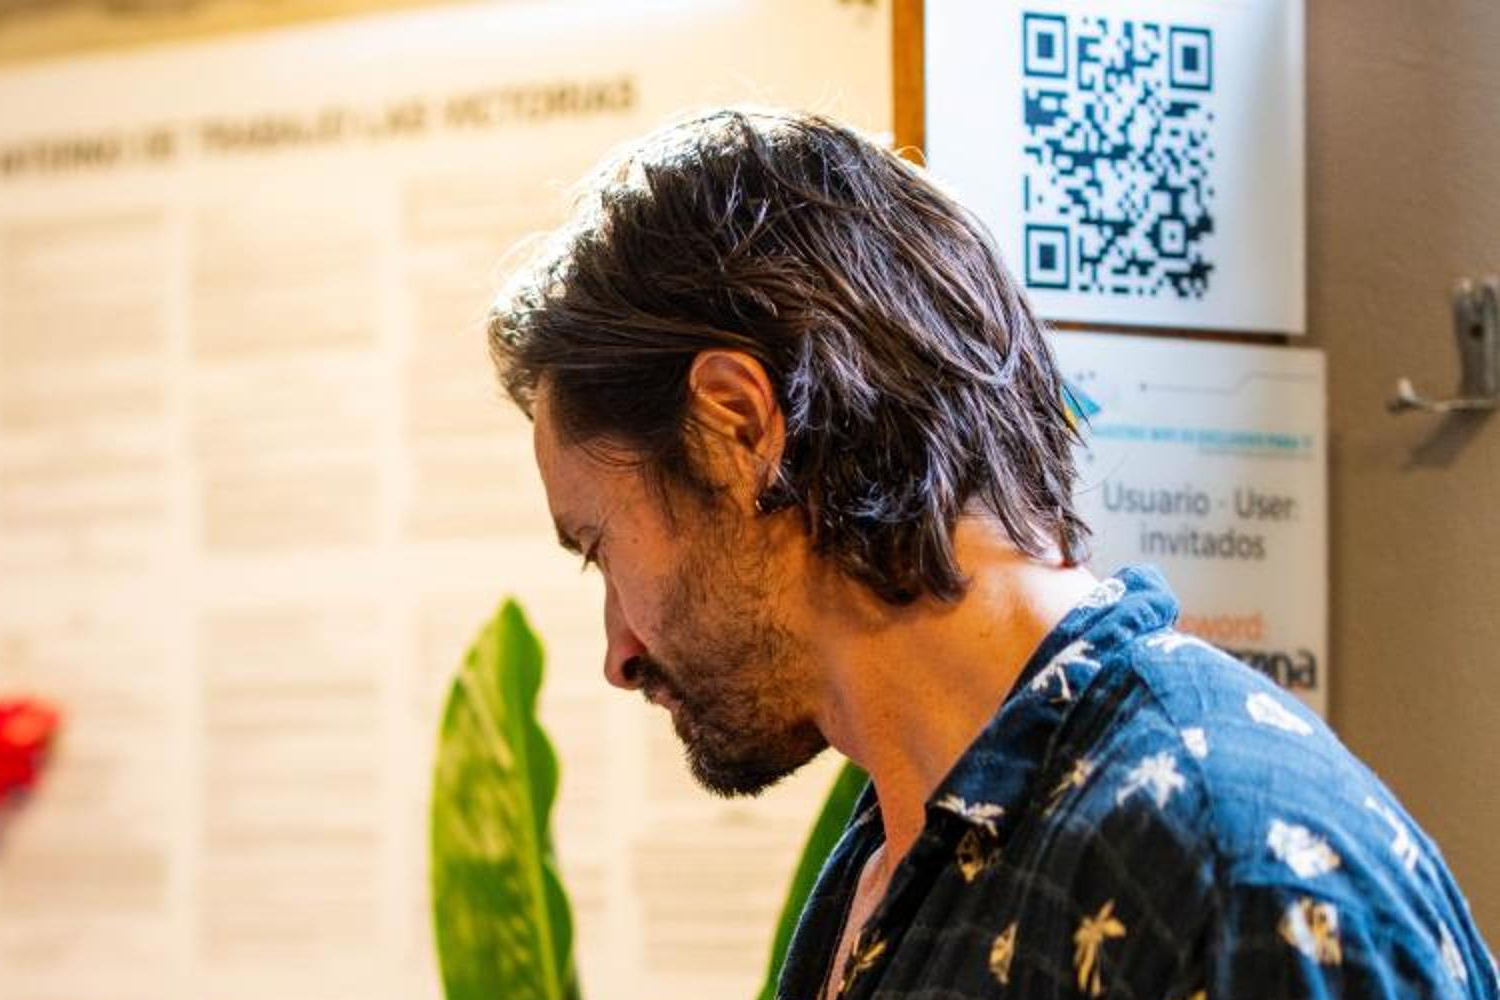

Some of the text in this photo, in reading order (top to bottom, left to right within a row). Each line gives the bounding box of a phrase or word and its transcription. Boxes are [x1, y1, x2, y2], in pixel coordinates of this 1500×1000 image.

[1101, 480, 1210, 516] Usuario
[1231, 487, 1299, 521] User
[1138, 520, 1267, 561] invitados
